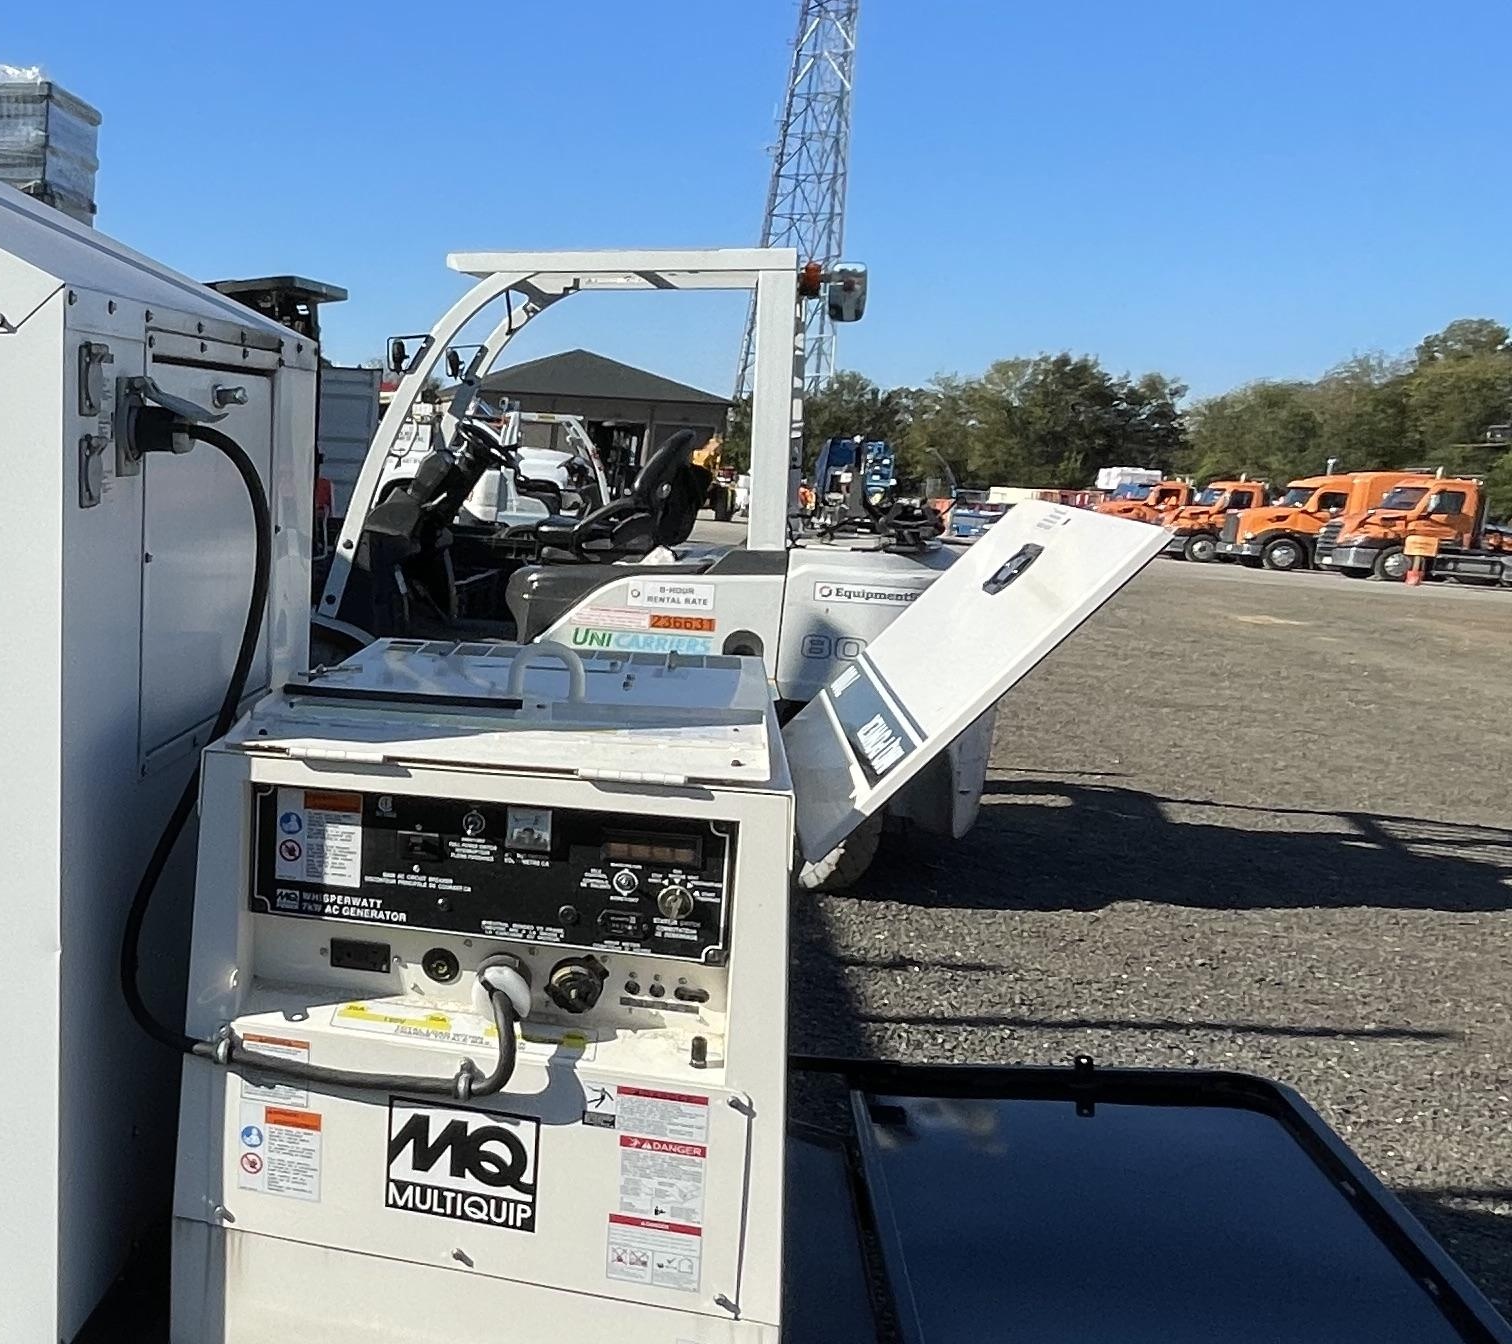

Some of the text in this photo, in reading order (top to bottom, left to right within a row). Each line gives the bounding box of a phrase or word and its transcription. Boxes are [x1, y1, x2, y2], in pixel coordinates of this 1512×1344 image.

[647, 595, 708, 607] RENTAL RATE
[324, 904, 340, 916] AC
[342, 906, 407, 923] GENERATOR
[387, 1112, 536, 1196] MQ
[651, 1141, 703, 1157] DANGER
[388, 1181, 533, 1228] MULTIQUIP
